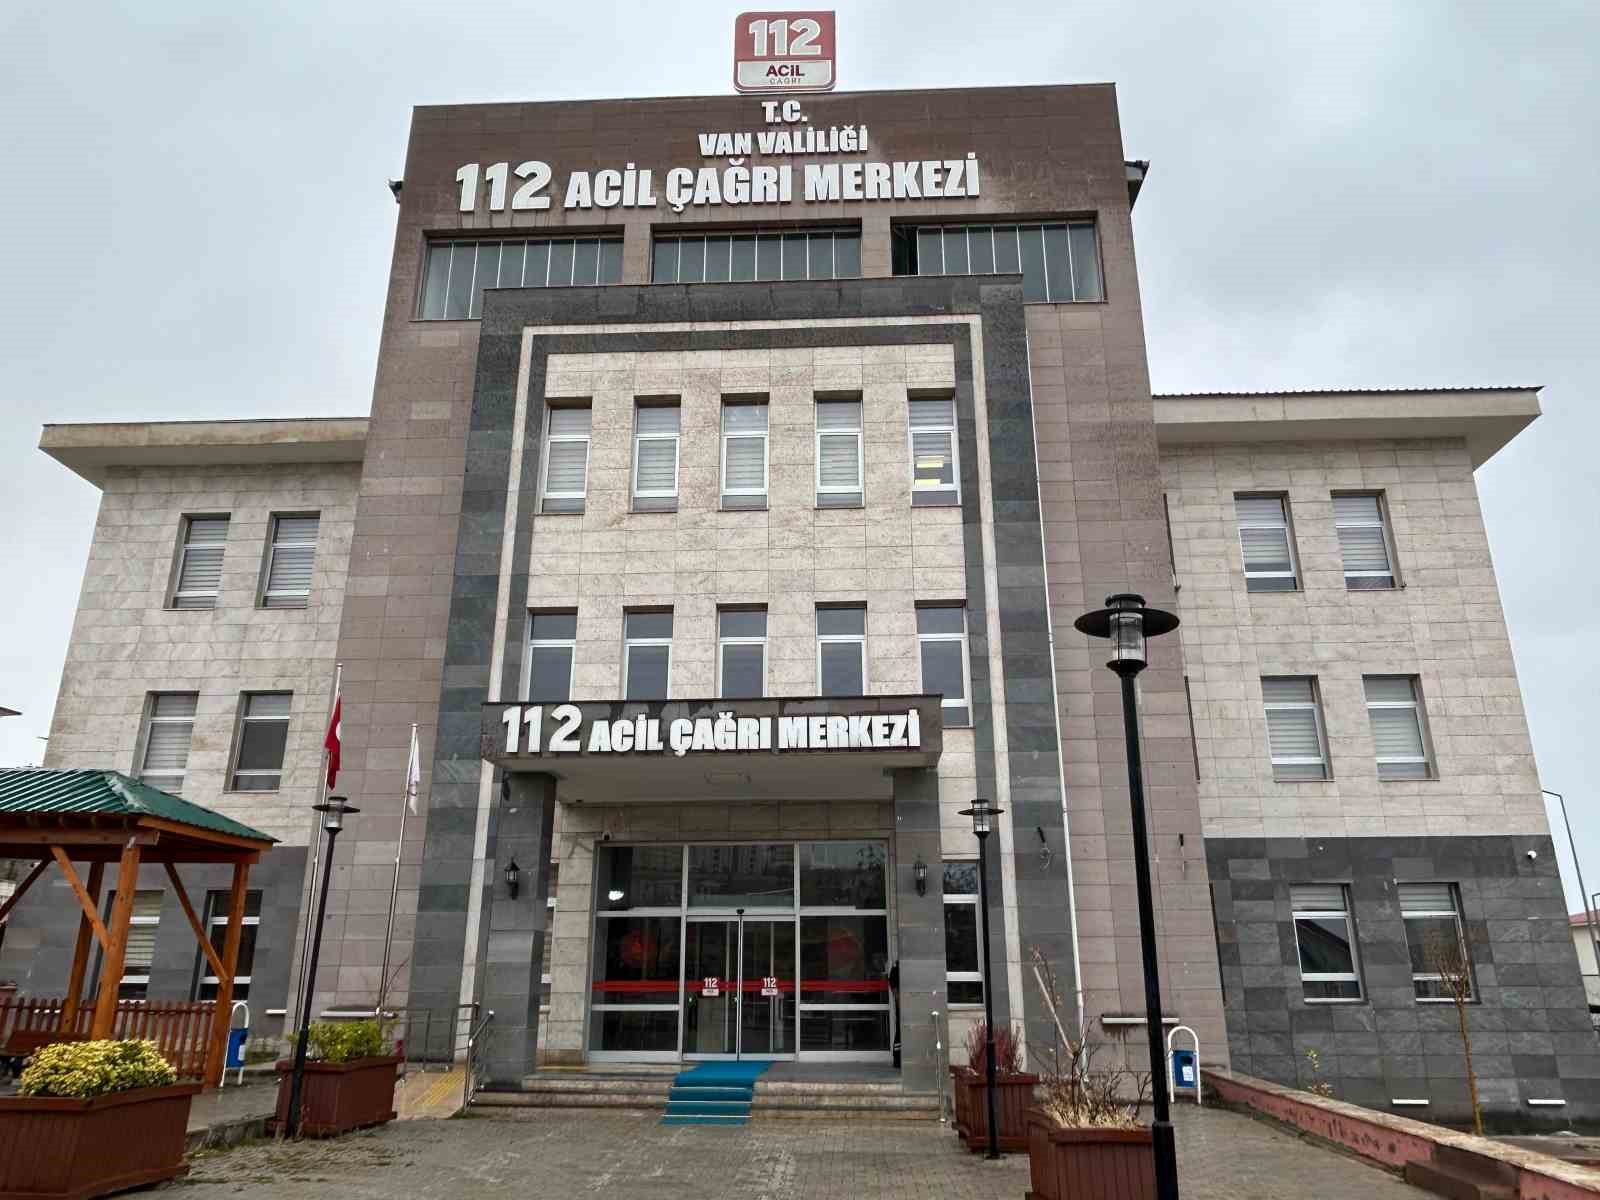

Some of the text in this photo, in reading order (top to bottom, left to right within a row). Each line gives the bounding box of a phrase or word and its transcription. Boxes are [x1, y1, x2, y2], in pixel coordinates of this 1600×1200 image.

[748, 18, 821, 56] 112
[761, 100, 808, 123] T.C.
[698, 125, 868, 156] VAN VALİLİĞİ
[456, 152, 980, 213] 112 ACİL ÇAĞRI MERKEZİ
[502, 704, 921, 757] 112 ACİL ÇAĞRI MERKEZİ
[704, 977, 718, 988] 112
[763, 977, 777, 988] 112
